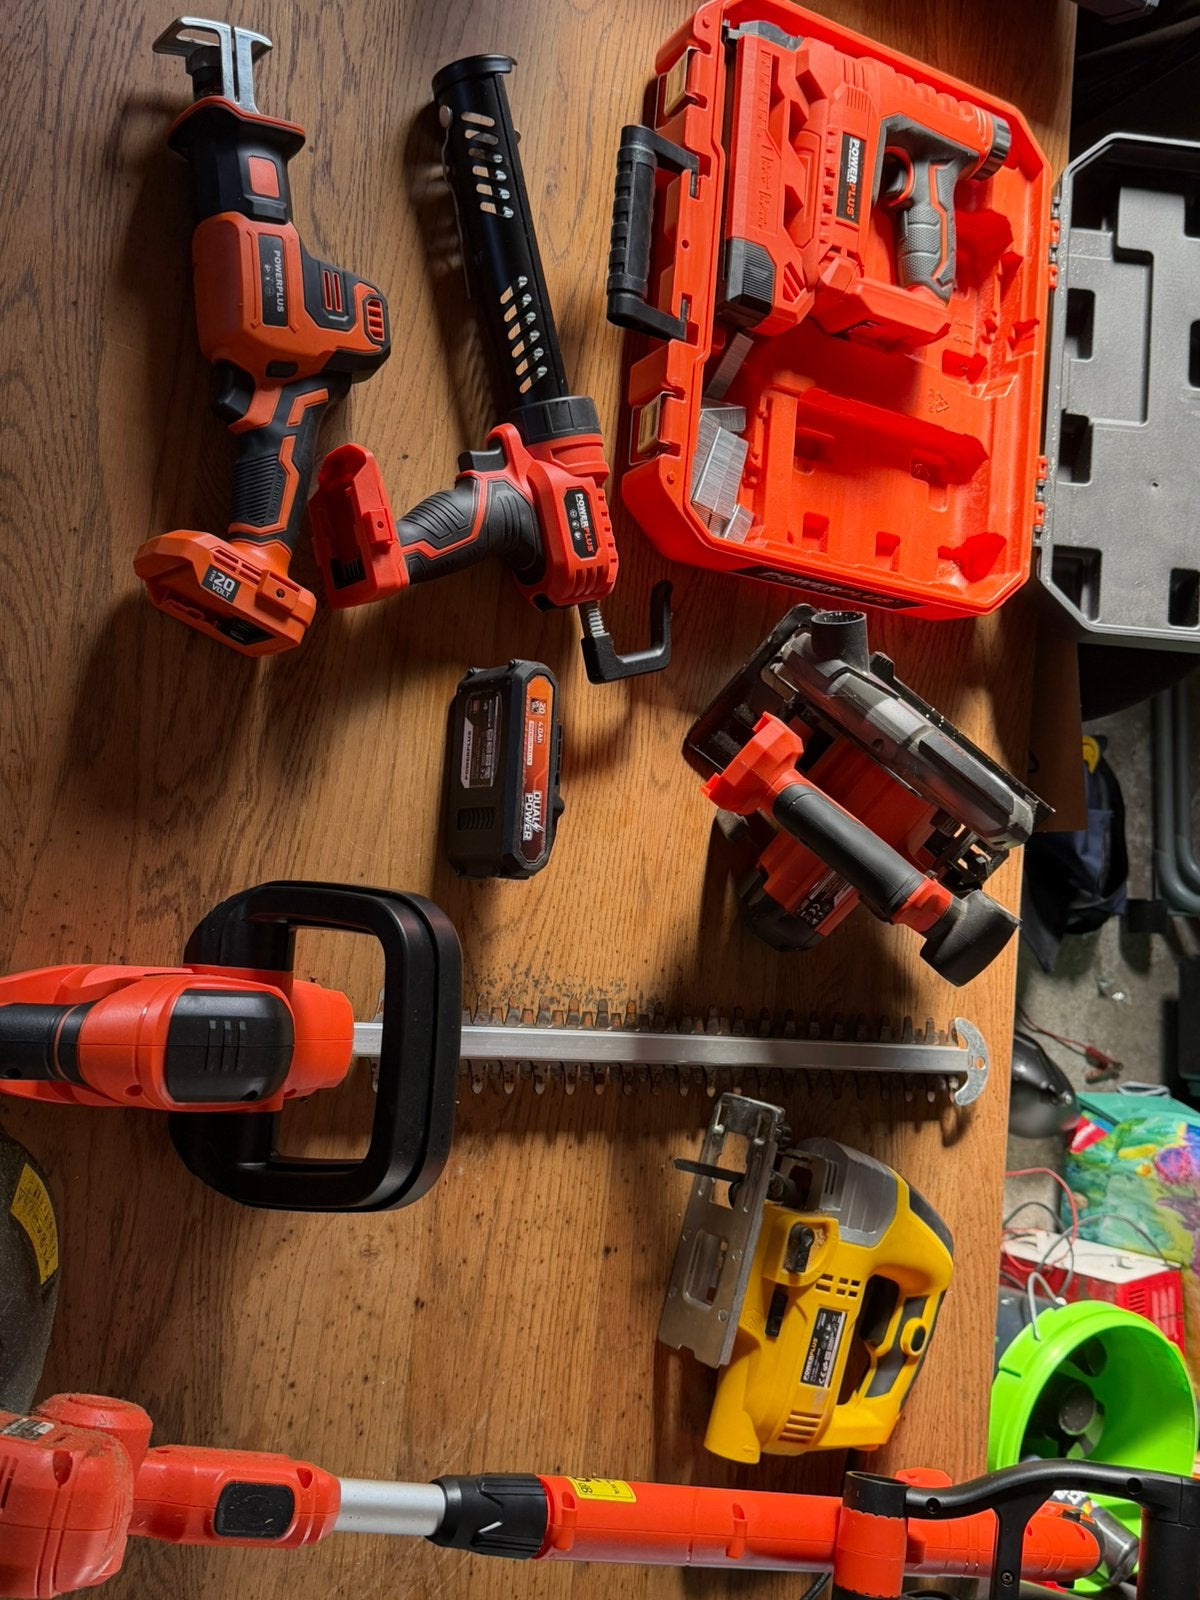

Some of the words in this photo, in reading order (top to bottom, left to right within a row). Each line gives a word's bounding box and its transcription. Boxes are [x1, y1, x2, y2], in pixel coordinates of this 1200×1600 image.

[846, 139, 861, 215] POWERPLUS
[273, 250, 285, 313] POWERPLUS
[577, 493, 594, 552] POWERPLUS
[208, 570, 217, 582] MAX
[212, 583, 231, 598] VOLT
[213, 572, 236, 592] 20
[758, 571, 895, 602] POWERPLUS
[539, 702, 546, 714] 20
[464, 730, 472, 781] POWERPLUS
[523, 793, 533, 841] POWER
[532, 790, 542, 823] DUAL
[802, 1337, 818, 1381] POWERPLUS
